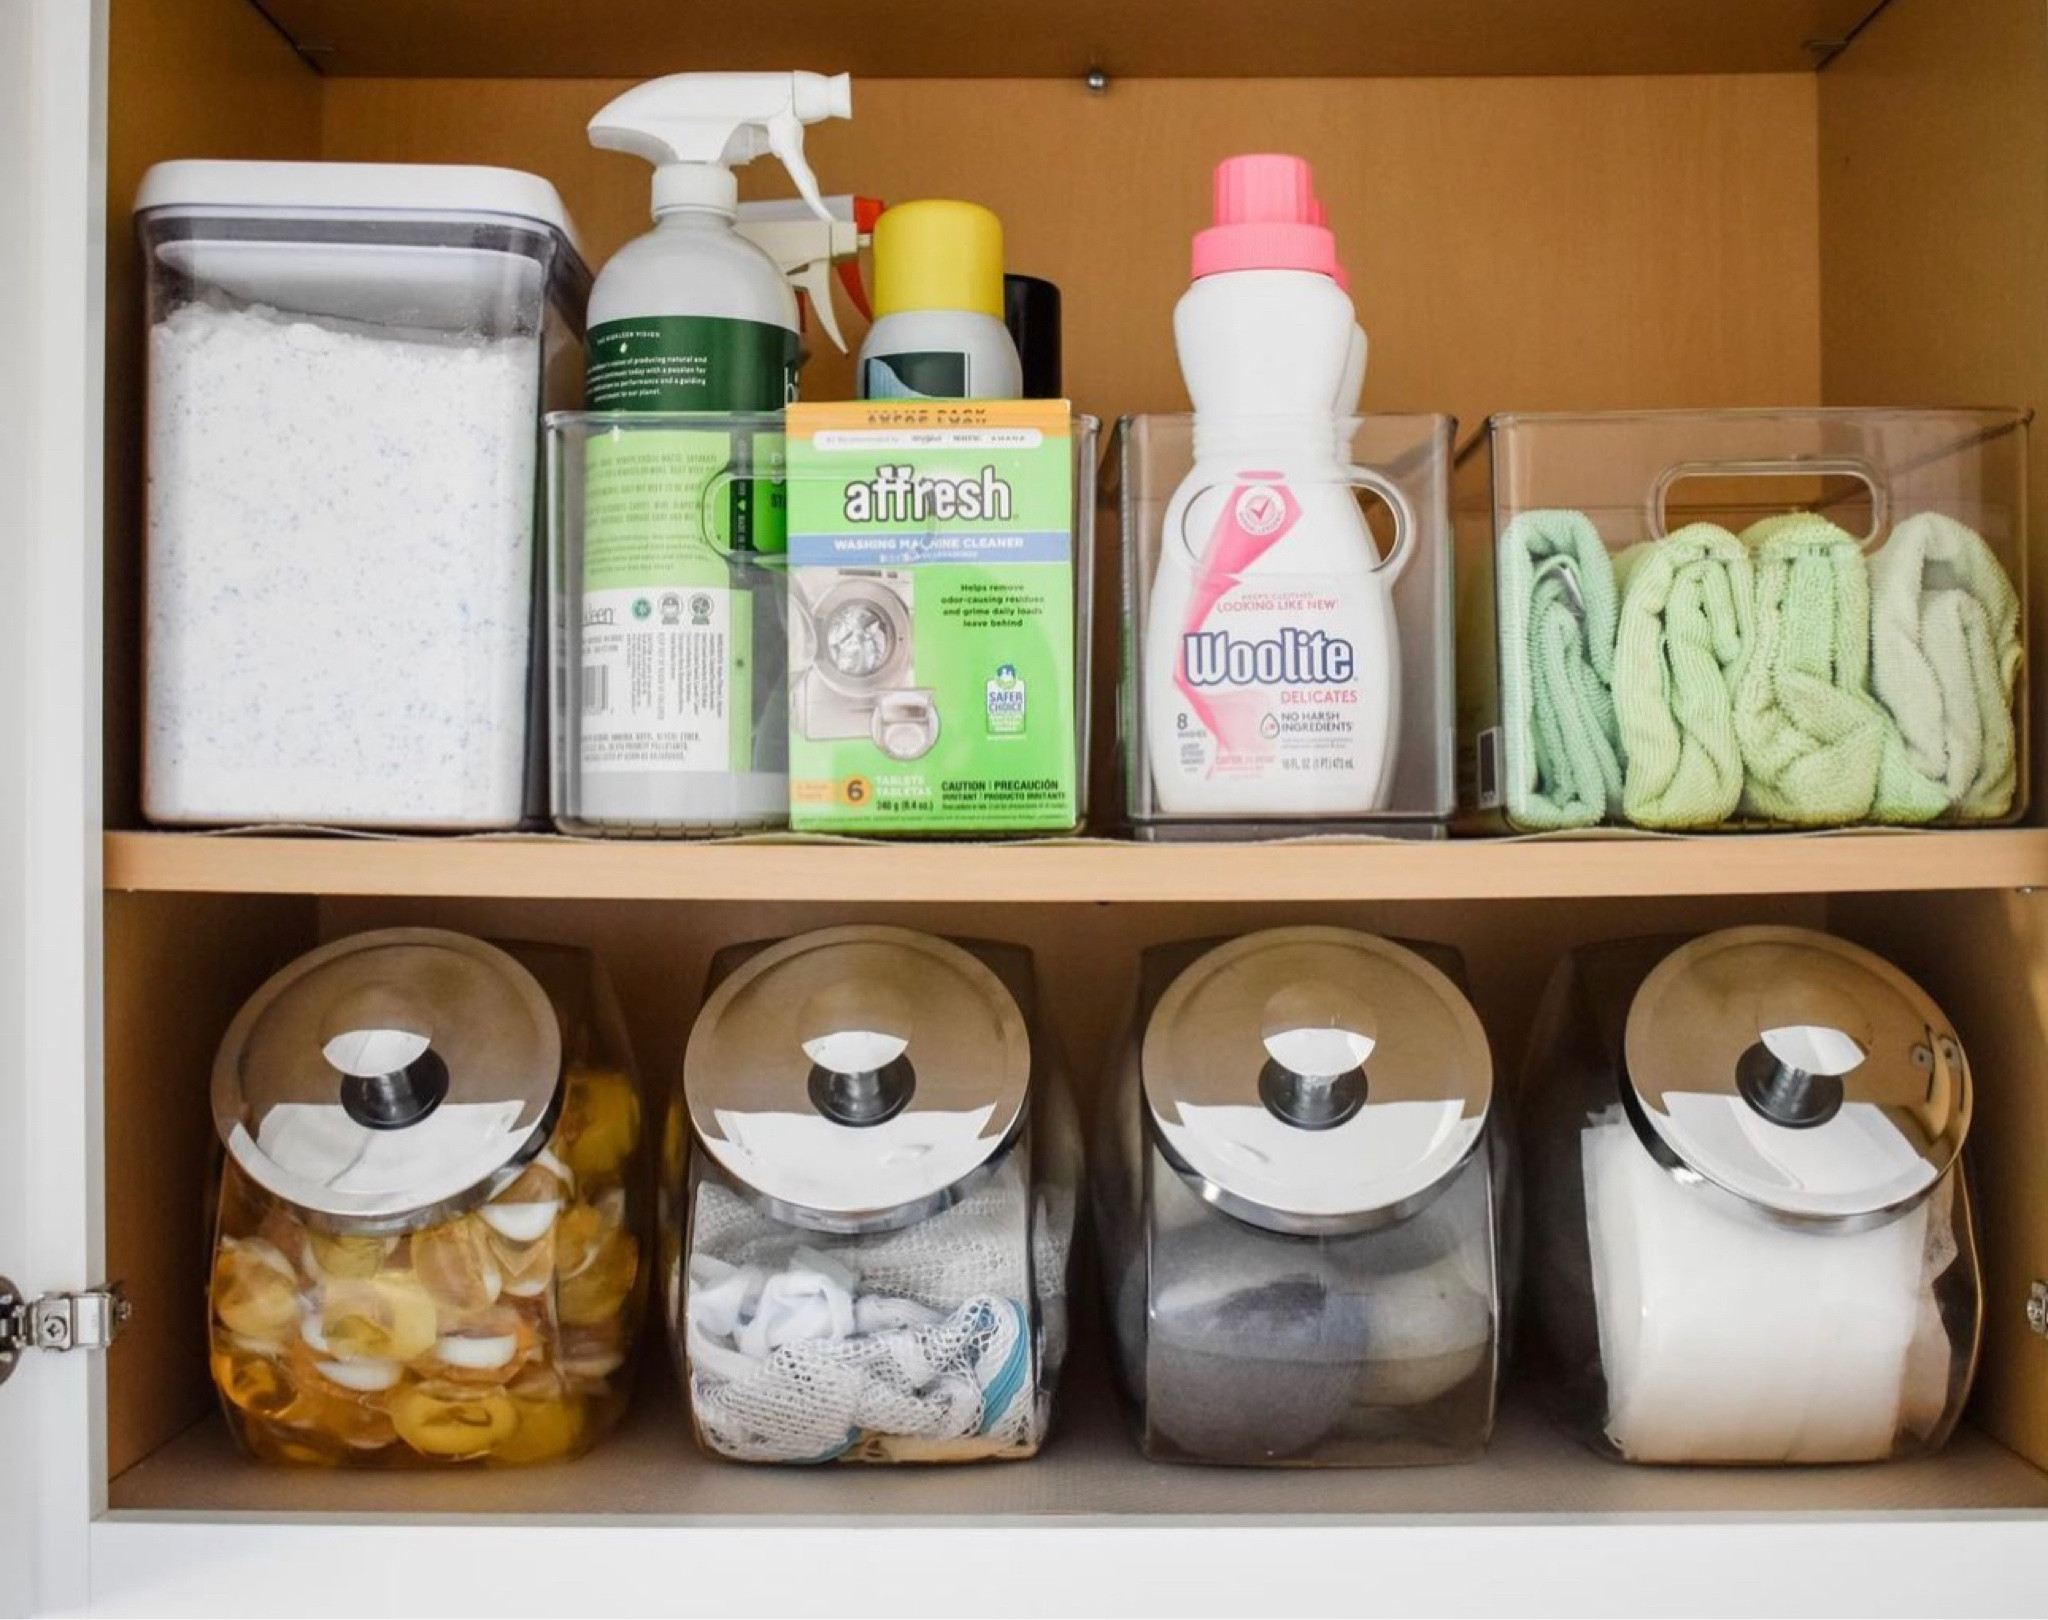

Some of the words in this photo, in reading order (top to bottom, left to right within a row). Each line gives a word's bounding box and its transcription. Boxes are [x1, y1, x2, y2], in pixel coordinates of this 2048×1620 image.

[634, 356, 666, 366] producing
[667, 355, 693, 363] natural
[694, 355, 708, 363] and
[668, 367, 694, 375] passion
[660, 377, 673, 385] and
[680, 377, 706, 387] guiding
[844, 464, 1012, 522] affresh
[834, 538, 897, 551] WASHING
[963, 536, 1024, 549] CLEANER
[960, 584, 987, 592] Helps
[941, 596, 1003, 605] odor-causing
[1005, 596, 1044, 604] residues
[1216, 601, 1274, 613] LOOKING
[1277, 600, 1304, 611] LIKE
[1307, 599, 1336, 611] NEW
[943, 608, 960, 616] and
[962, 608, 989, 617] grime
[992, 607, 1014, 616] daily
[1017, 607, 1042, 615] loads
[963, 619, 988, 628] leave
[990, 618, 1023, 628] behind
[1183, 626, 1354, 686] Woolite
[988, 691, 1023, 703] SAFER
[1280, 690, 1358, 704] DELICATES
[1177, 712, 1188, 730] 8
[1281, 712, 1300, 721] NO
[1302, 711, 1340, 721] HARSH
[1281, 721, 1353, 733] INGREDIENTS
[876, 775, 925, 785] TABLETS
[941, 780, 987, 791] CAUTION
[993, 778, 1058, 791] PRECAUCIÓN
[847, 778, 865, 803] 6
[876, 786, 933, 797] TABLETAS
[942, 792, 978, 801] IRRITANT
[983, 792, 1024, 801] PRODUCTO
